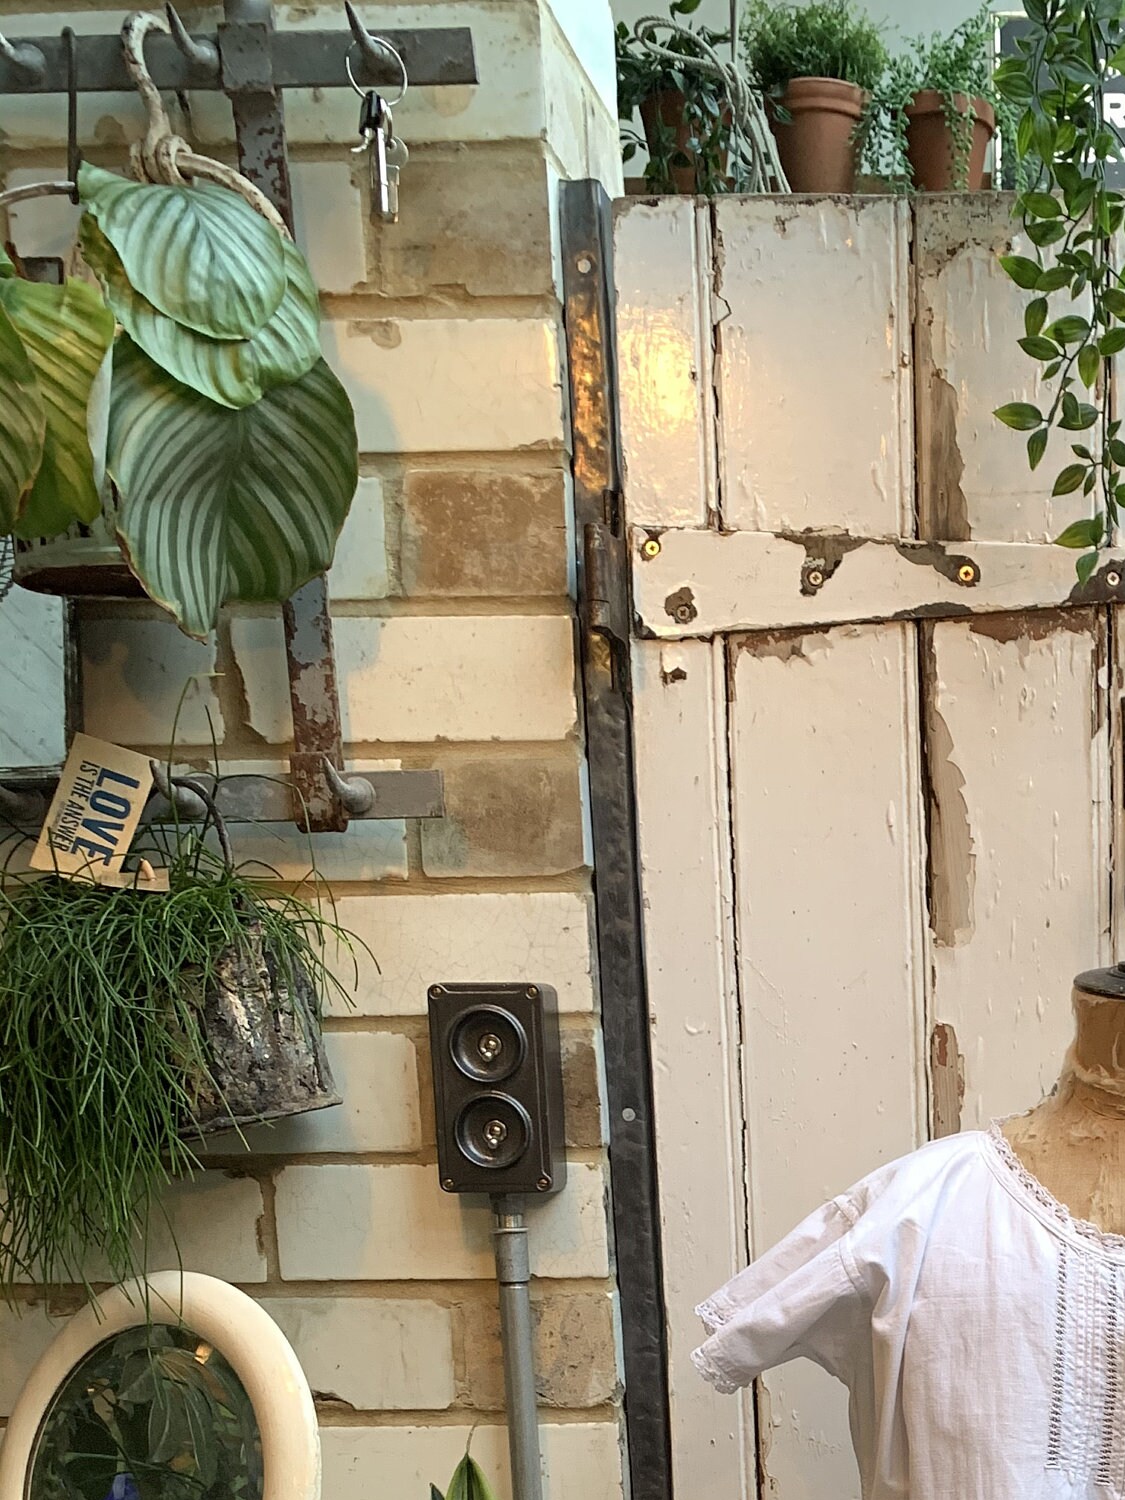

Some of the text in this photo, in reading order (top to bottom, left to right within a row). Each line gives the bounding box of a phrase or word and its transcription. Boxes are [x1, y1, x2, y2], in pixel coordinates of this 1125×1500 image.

[52, 760, 99, 853] IS THE ANSWER
[70, 767, 140, 866] LOVE
